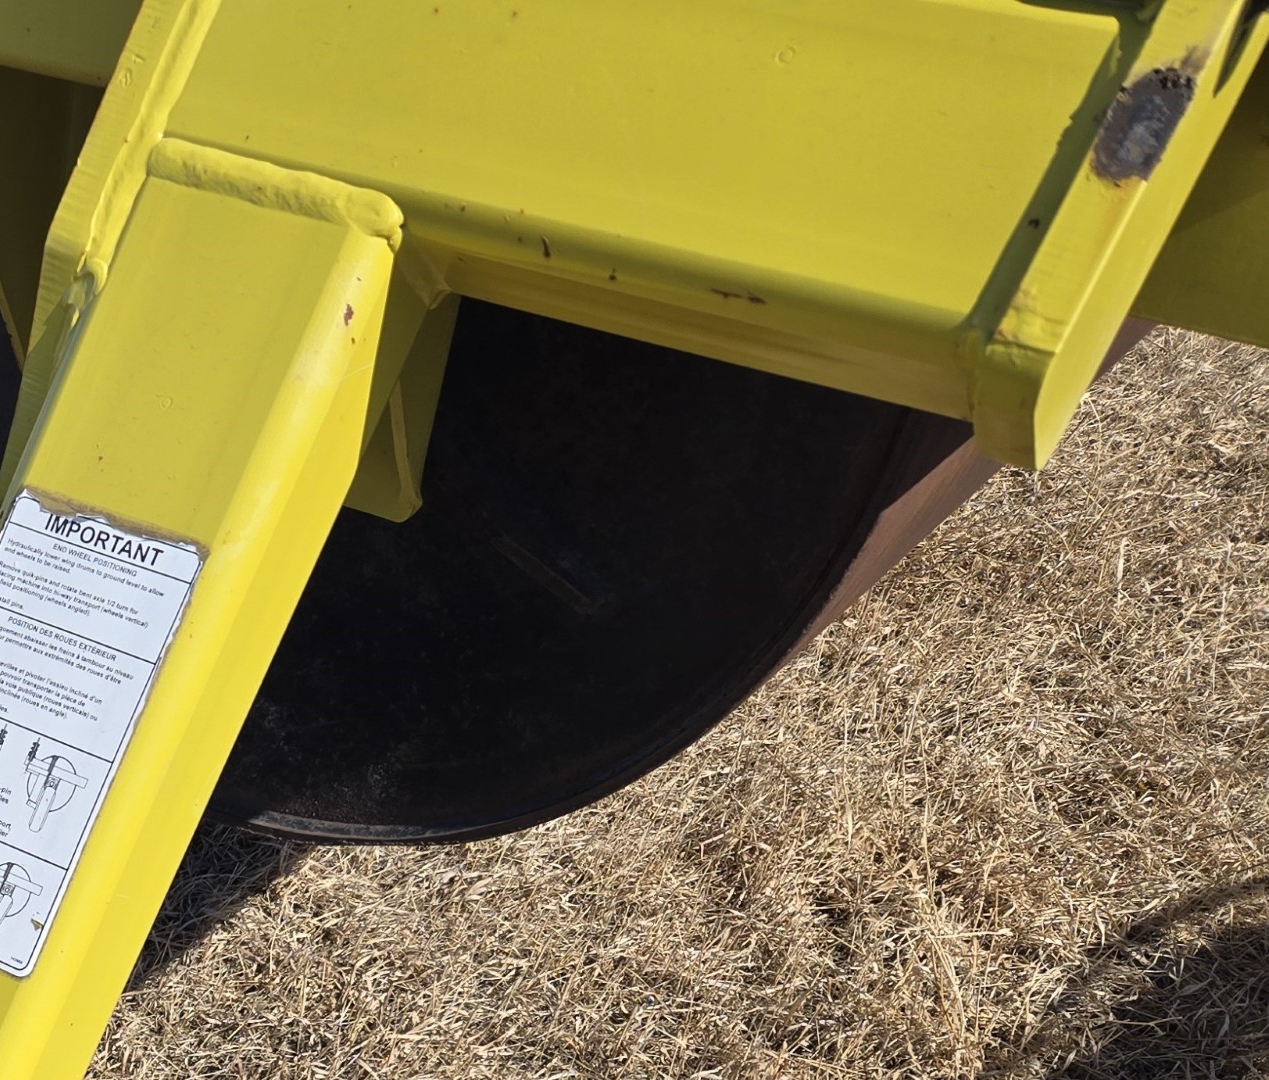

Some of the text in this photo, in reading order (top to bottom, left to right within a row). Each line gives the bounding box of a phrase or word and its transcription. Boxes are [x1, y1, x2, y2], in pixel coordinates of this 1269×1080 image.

[3, 546, 16, 554] end
[15, 550, 35, 561] wheels
[43, 559, 51, 567] be
[44, 513, 164, 567] IMPORTANT
[6, 537, 44, 556] Hydraulically
[43, 551, 60, 561] lower
[60, 557, 75, 567] wing
[75, 562, 95, 573] drums
[95, 568, 103, 576] to
[102, 571, 125, 584] ground
[125, 578, 140, 588] level
[147, 587, 165, 597] allow
[52, 542, 137, 577] END WHEEL POSITIONING
[0, 578, 12, 587] field
[11, 584, 44, 600] positioning
[43, 595, 67, 608] (wheels
[16, 576, 40, 589] machine
[40, 585, 52, 593] into
[52, 589, 72, 601] hi-way
[72, 596, 100, 611] transport
[100, 606, 124, 619] (wheels
[124, 615, 148, 629] vertical)
[48, 579, 60, 587] and
[60, 583, 78, 593] rotate
[78, 589, 92, 598] bent
[106, 599, 115, 607] 1/2
[115, 602, 129, 611] turn
[128, 607, 139, 615] for
[4, 636, 32, 651] permettre
[32, 646, 43, 655] aux
[75, 662, 86, 671] des
[86, 666, 104, 677] roues
[7, 615, 117, 661] POSITION DES ROUES EXTÉRIEUR
[23, 634, 48, 647] abaisser
[48, 643, 57, 651] les
[57, 646, 75, 657] freins
[80, 655, 105, 669] tambour
[105, 664, 114, 672] au
[114, 668, 134, 680] niveau
[0, 669, 22, 682] pouvoir
[21, 678, 54, 694] transporter
[24, 670, 46, 682] pivoter
[5, 680, 17, 689] voie
[17, 685, 43, 699] publique
[42, 695, 62, 707] (roues
[89, 713, 98, 721] ou
[20, 695, 40, 707] (roues
